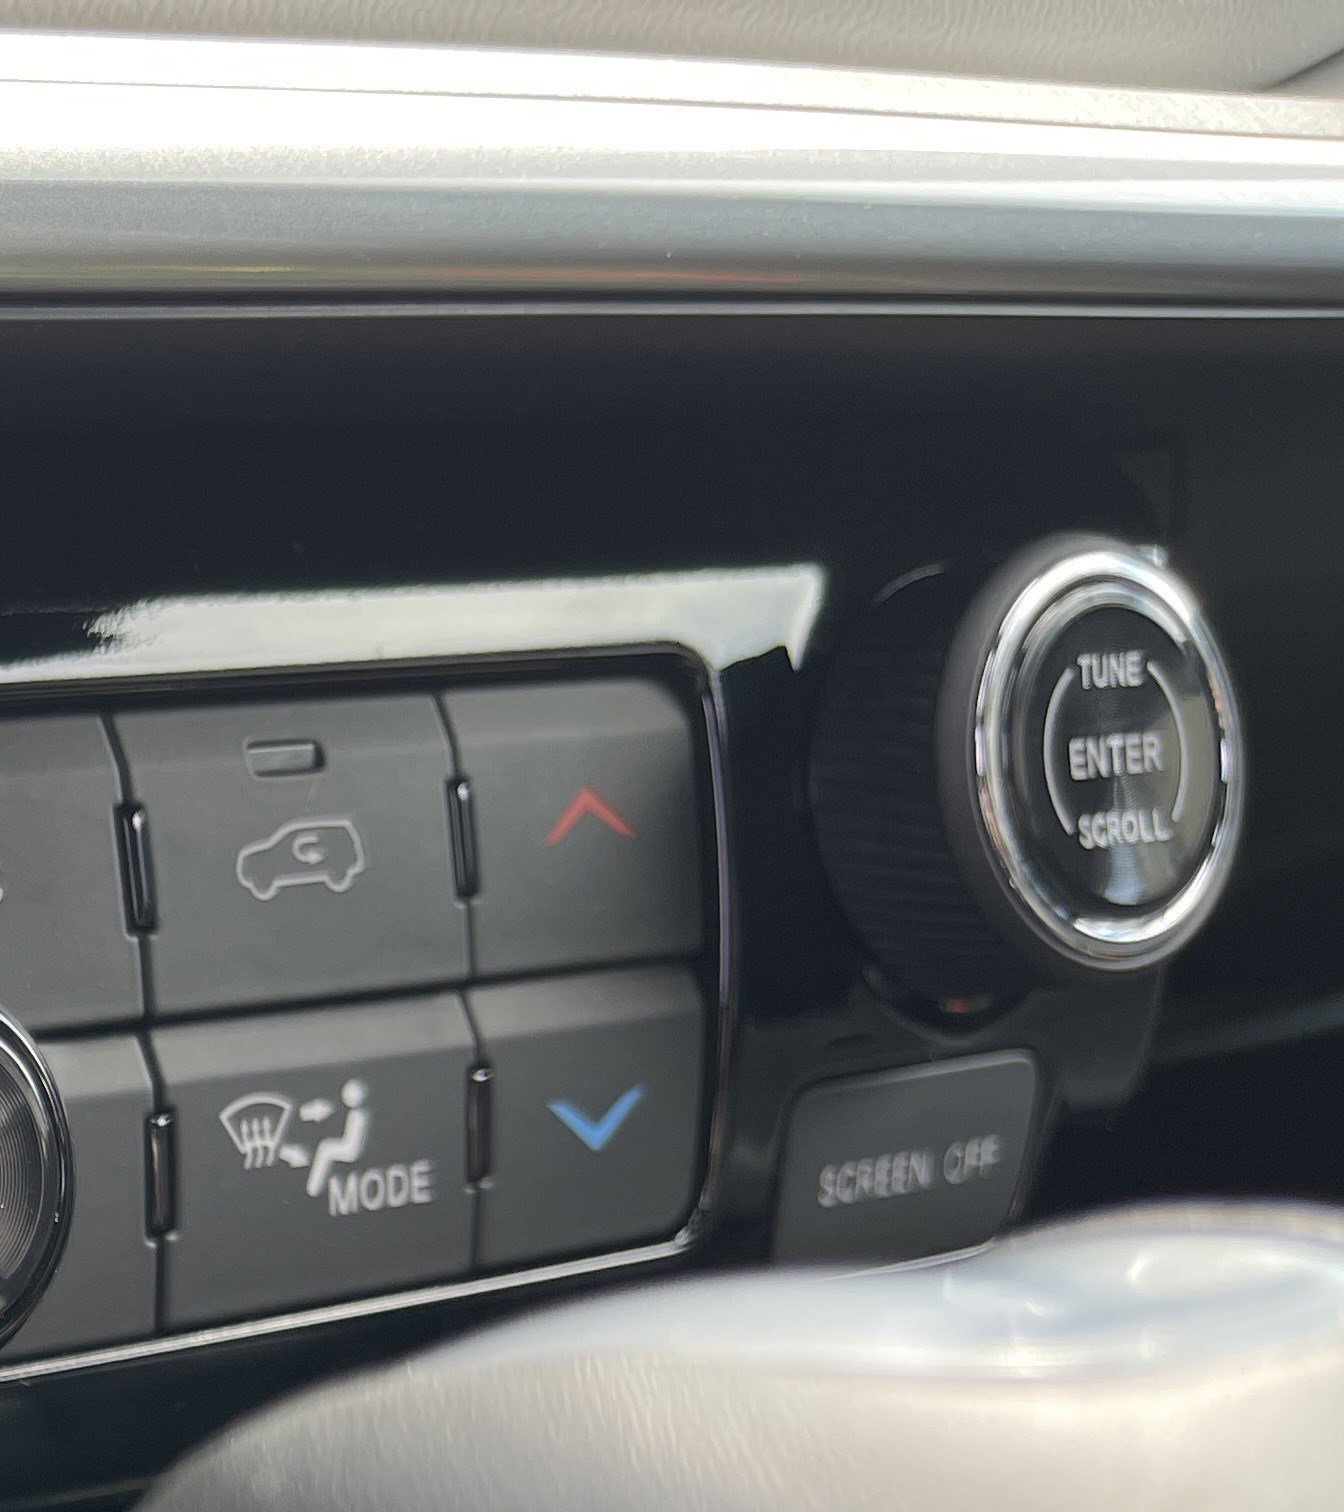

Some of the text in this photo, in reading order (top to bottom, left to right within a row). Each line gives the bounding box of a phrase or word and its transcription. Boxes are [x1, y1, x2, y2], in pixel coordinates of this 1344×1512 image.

[1076, 651, 1143, 690] TUNE
[1068, 731, 1166, 782] ENTER
[1077, 808, 1174, 851] SCROLL
[329, 1160, 432, 1215] MODE
[817, 1135, 1002, 1208] SCREEN OFF
